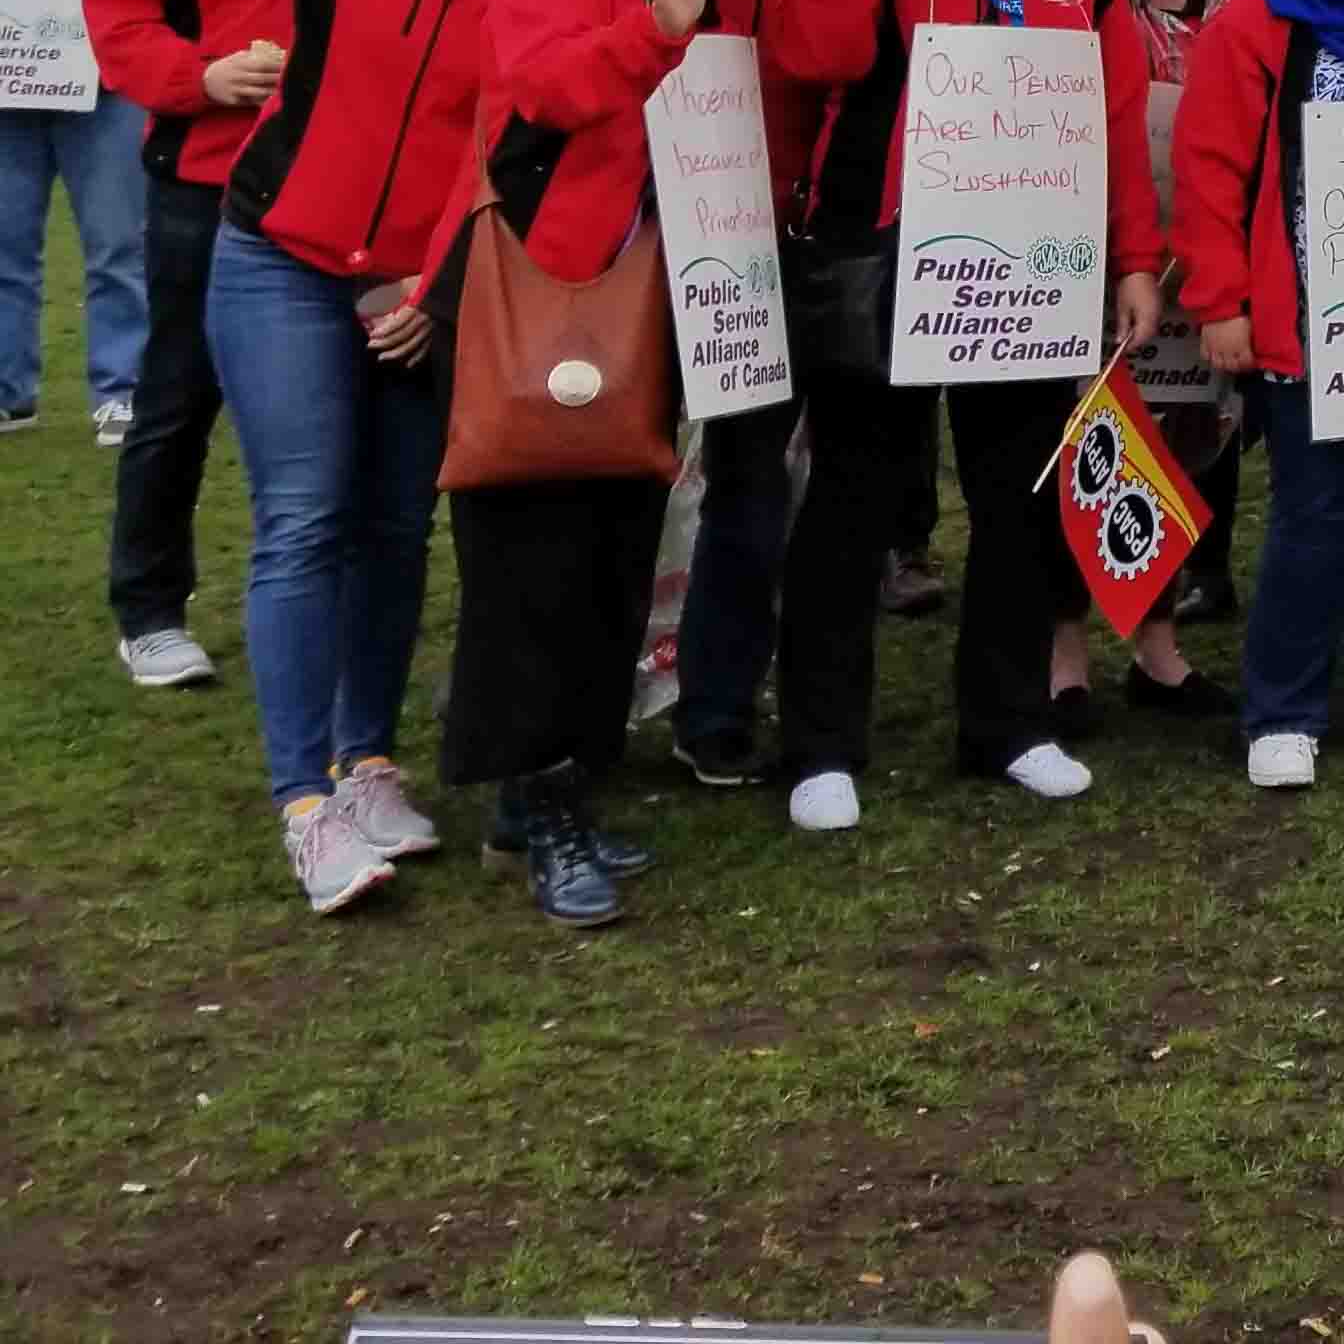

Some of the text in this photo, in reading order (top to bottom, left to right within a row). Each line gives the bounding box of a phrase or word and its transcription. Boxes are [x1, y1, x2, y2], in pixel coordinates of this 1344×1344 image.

[0, 45, 61, 60] ervice
[8, 80, 86, 97] Canada
[907, 109, 982, 144] ARE
[993, 109, 1044, 141] NOT
[913, 258, 1012, 281] Public
[685, 279, 741, 310] Public
[952, 284, 1062, 307] Service
[713, 304, 769, 335] Service
[909, 312, 1033, 336] Alliance
[692, 338, 760, 369] Alliance
[948, 335, 1090, 362] of Canada
[720, 356, 787, 392] of Canada
[1129, 364, 1211, 385] anada
[1084, 430, 1111, 486] AFPC
[1113, 500, 1151, 556] PSAC
